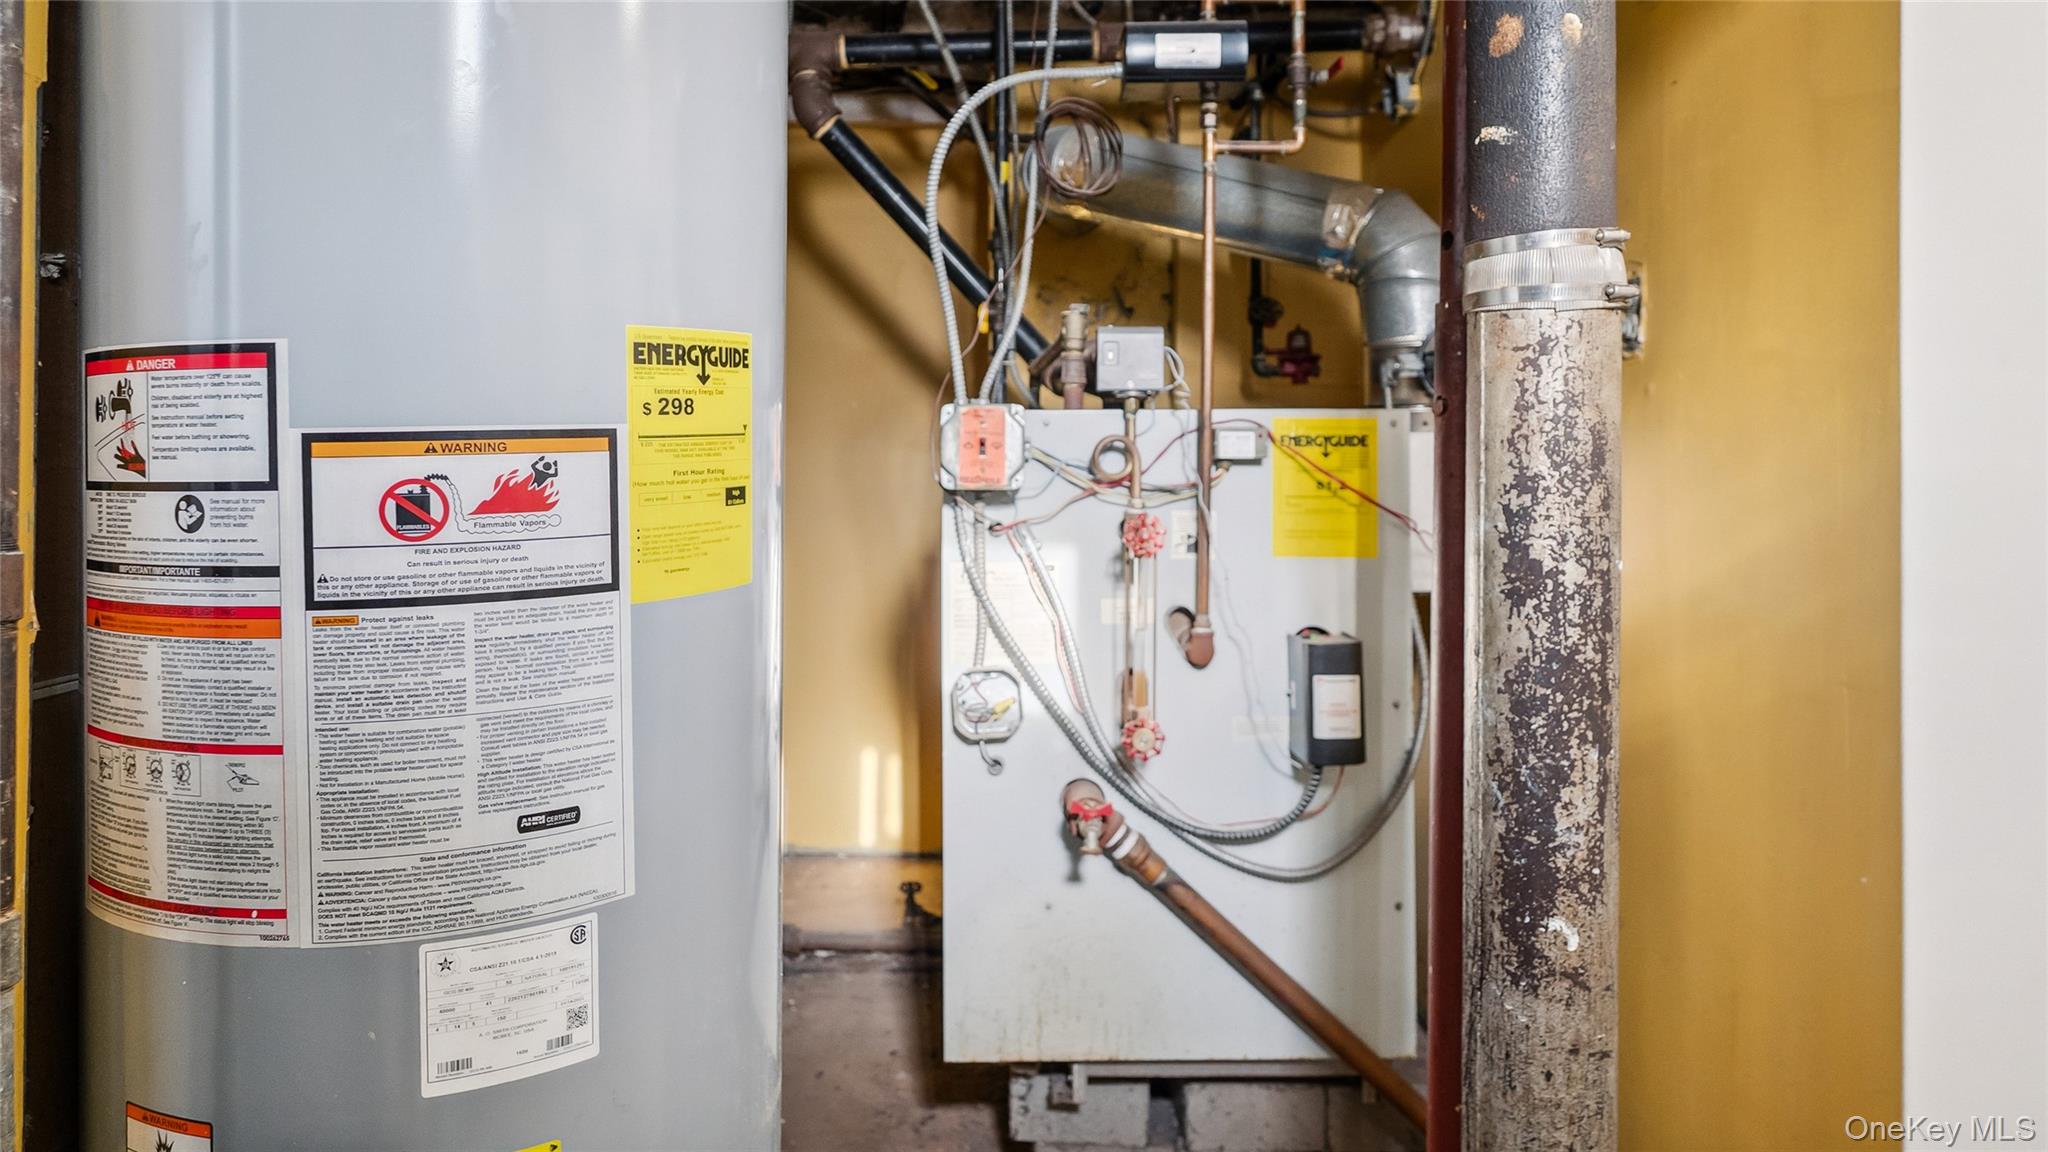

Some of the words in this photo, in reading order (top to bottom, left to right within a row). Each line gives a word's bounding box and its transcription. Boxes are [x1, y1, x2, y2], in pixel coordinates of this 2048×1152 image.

[633, 342, 749, 368] ENERGYGUIDE
[137, 359, 176, 370] DANGER
[658, 398, 694, 415] 298
[440, 442, 507, 454] WARNING
[1280, 435, 1368, 447] ENERGYGUIDE
[474, 519, 516, 528] Flammable
[519, 518, 547, 528] Vapors
[480, 557, 500, 565] injury
[397, 572, 428, 581] gasoline
[457, 569, 493, 577] flammable
[495, 568, 518, 577] vapors
[534, 564, 555, 574] liquids
[576, 561, 598, 571] vicinity
[374, 581, 410, 590] appliance.
[412, 579, 439, 588] Storage
[482, 575, 511, 584] gasoline
[521, 572, 539, 580] other
[540, 570, 573, 578] flammable
[574, 569, 596, 577] vapors
[317, 591, 340, 599] liquids
[363, 589, 388, 598] vicinity
[457, 584, 491, 594] appliance
[506, 581, 525, 589] result
[560, 577, 577, 586] injury
[388, 615, 414, 624] against
[546, 812, 576, 822] CERTIFIED
[450, 848, 491, 859] conformance
[492, 842, 527, 853] information
[149, 1114, 188, 1131] WARNING
